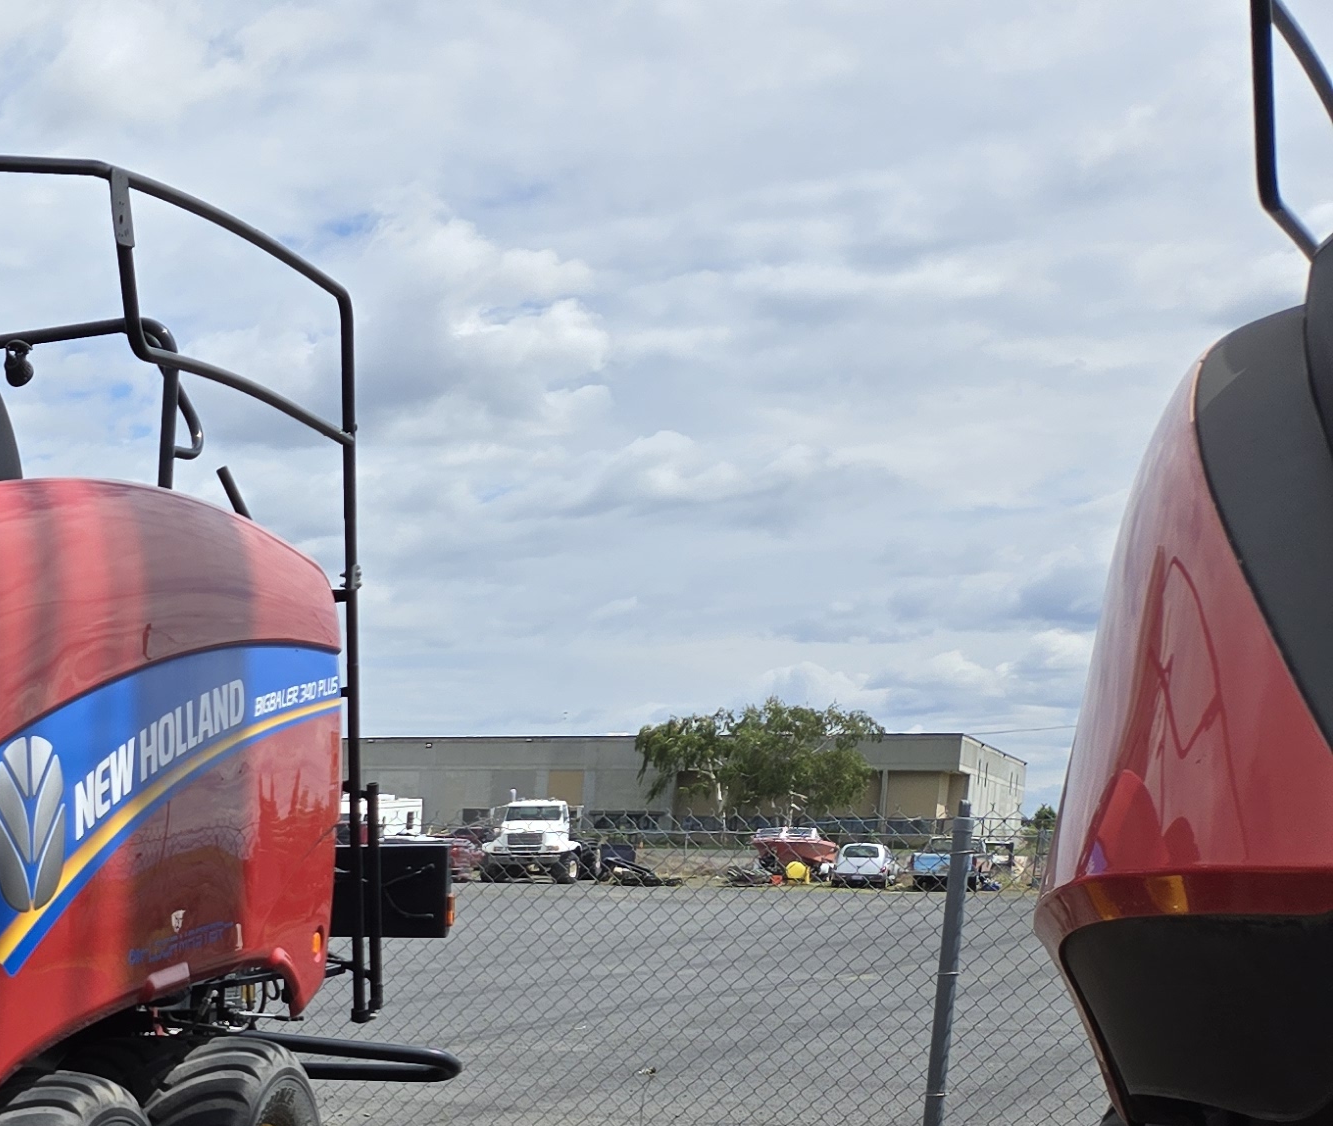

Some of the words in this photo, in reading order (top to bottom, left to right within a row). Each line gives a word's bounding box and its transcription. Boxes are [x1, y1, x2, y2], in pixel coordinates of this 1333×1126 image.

[254, 686, 299, 717] BIGBALER
[299, 681, 317, 703] 340
[317, 676, 339, 698] PLUS
[74, 737, 135, 841] NEW
[139, 678, 245, 783] HOLLAND
